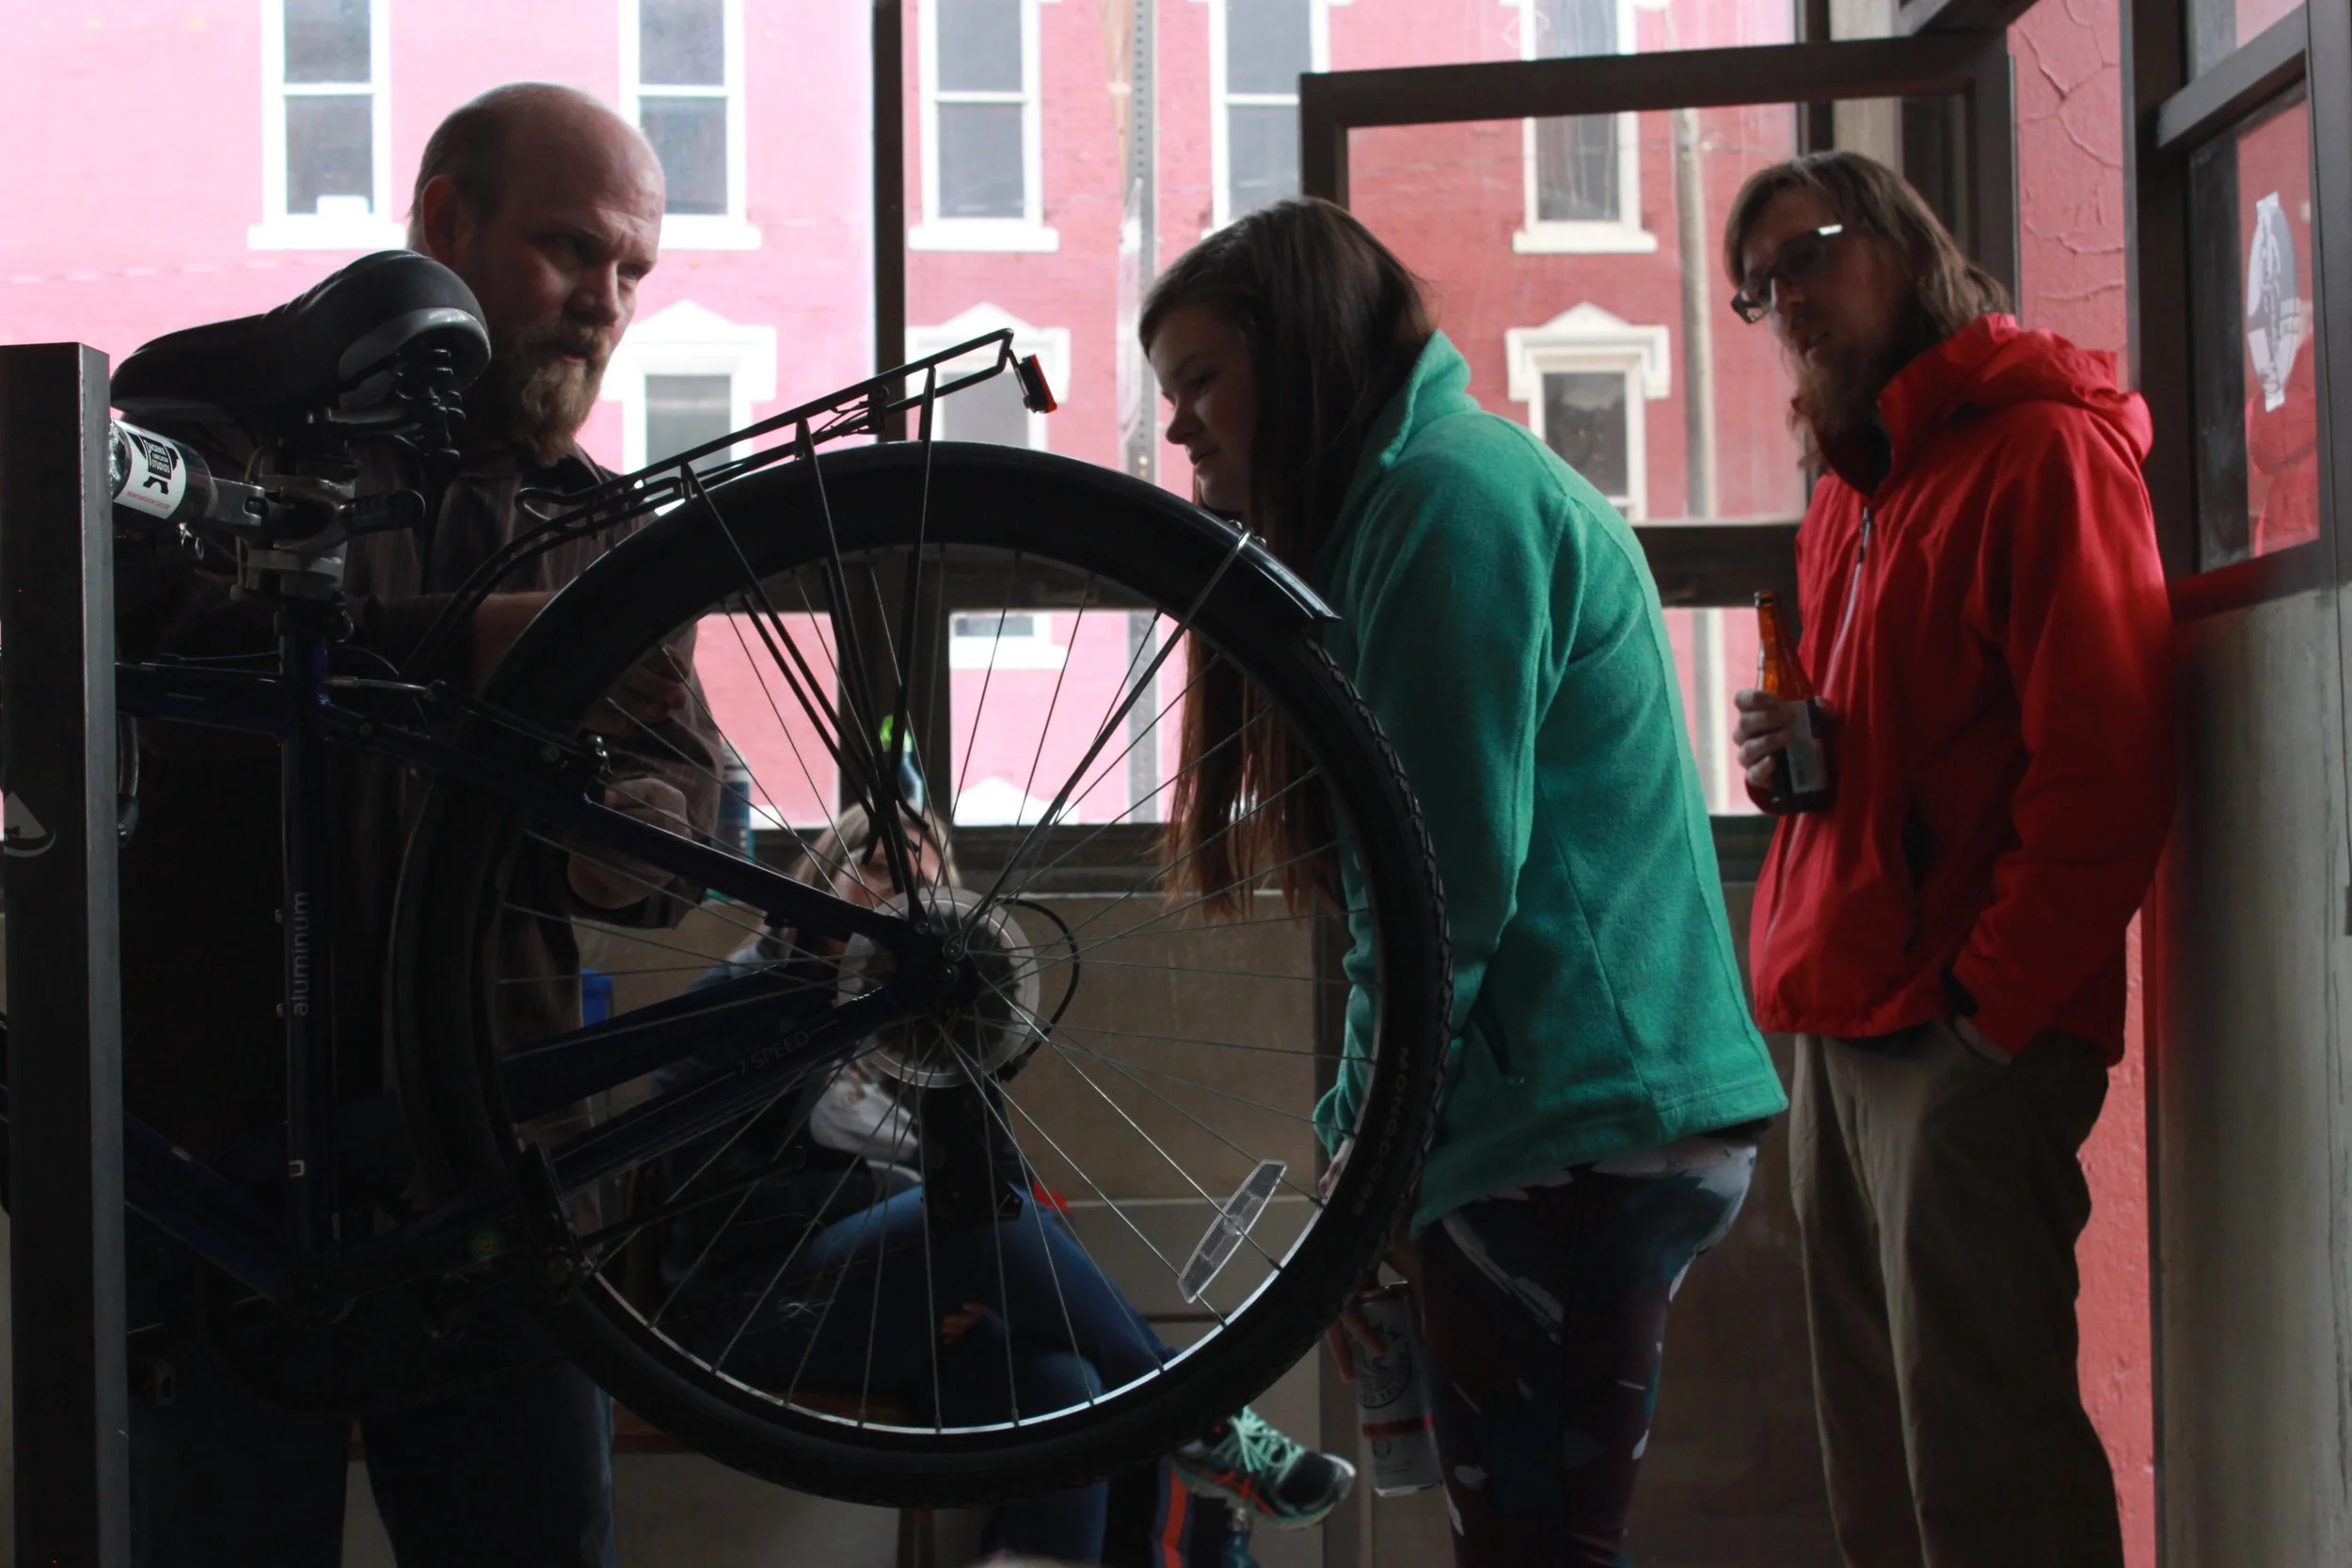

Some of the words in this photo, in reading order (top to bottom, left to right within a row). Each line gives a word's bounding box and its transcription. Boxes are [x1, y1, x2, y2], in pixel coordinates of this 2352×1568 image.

[292, 893, 310, 1016] aluminum
[736, 1060, 746, 1075] 7
[752, 1032, 808, 1068] SPEED
[1351, 1047, 1410, 1218] MONGOOSE
